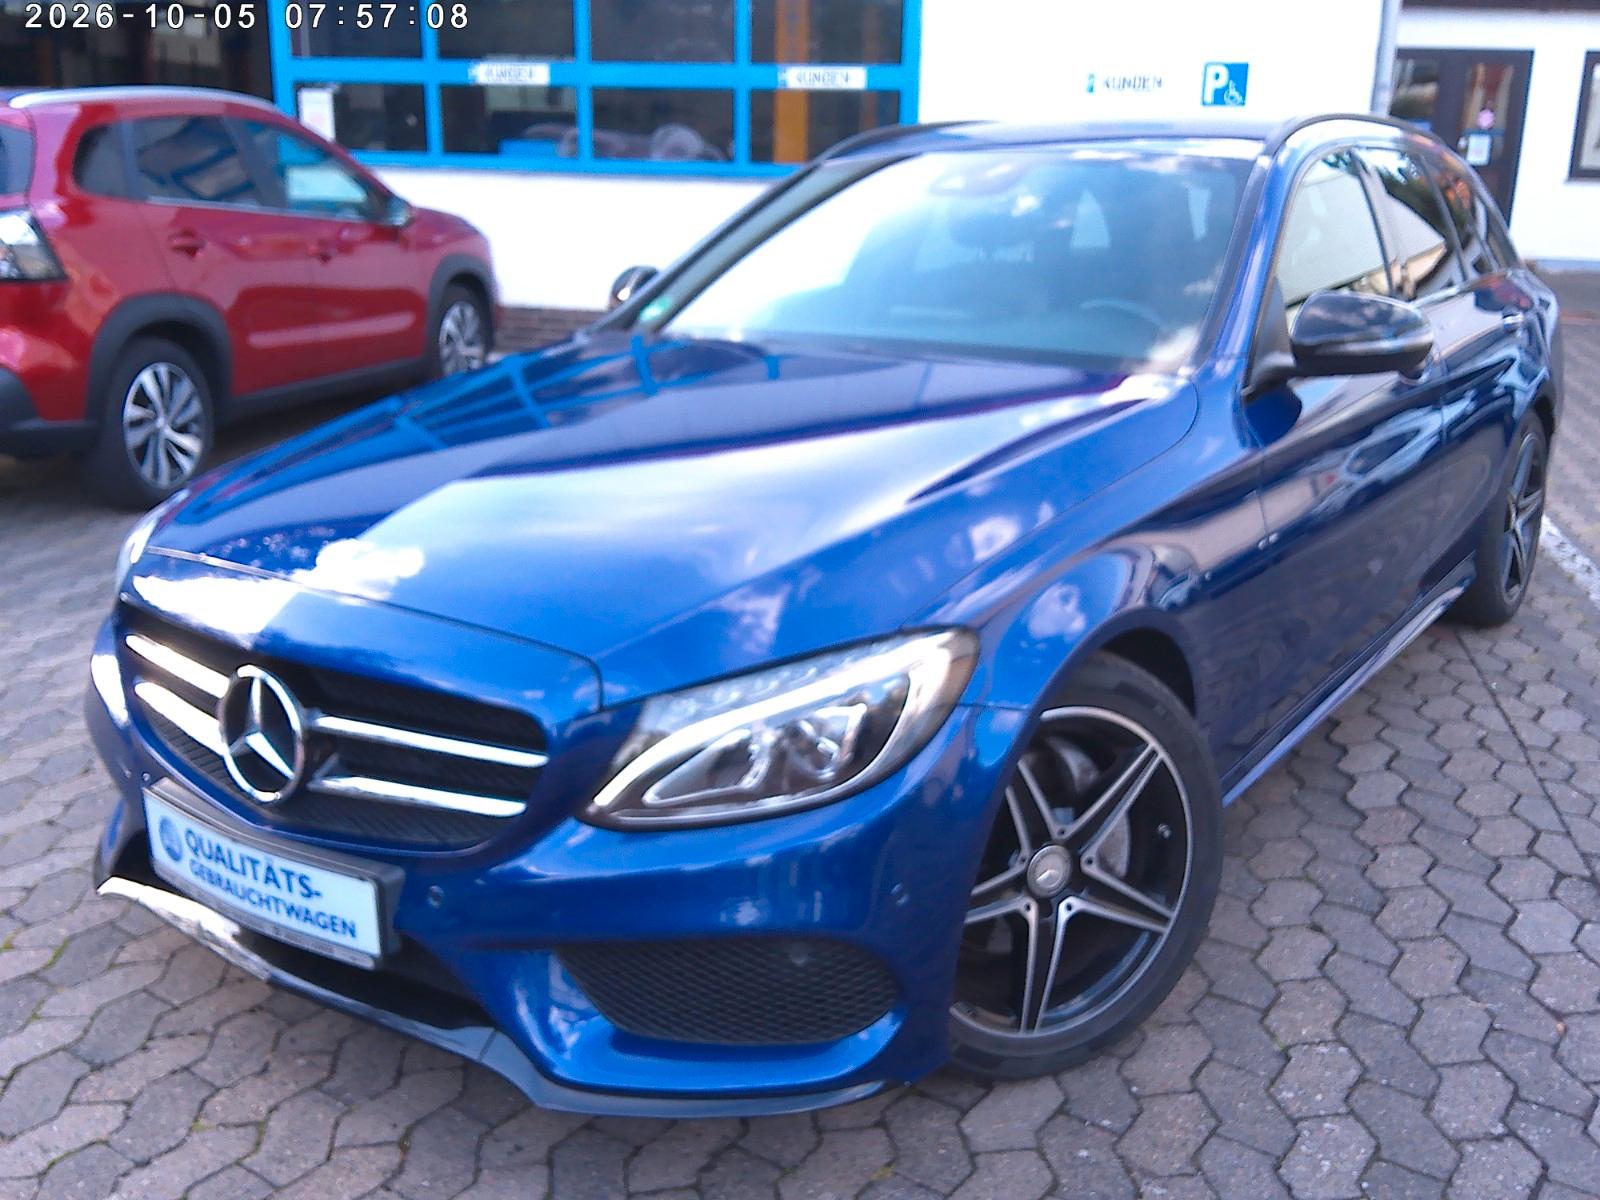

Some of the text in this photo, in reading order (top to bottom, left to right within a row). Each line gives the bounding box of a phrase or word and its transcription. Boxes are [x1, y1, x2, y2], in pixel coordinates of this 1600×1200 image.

[1203, 64, 1229, 104] P
[184, 829, 322, 898] QUALITÄTS-
[189, 858, 357, 938] GEBRAUCHTWAGEN
